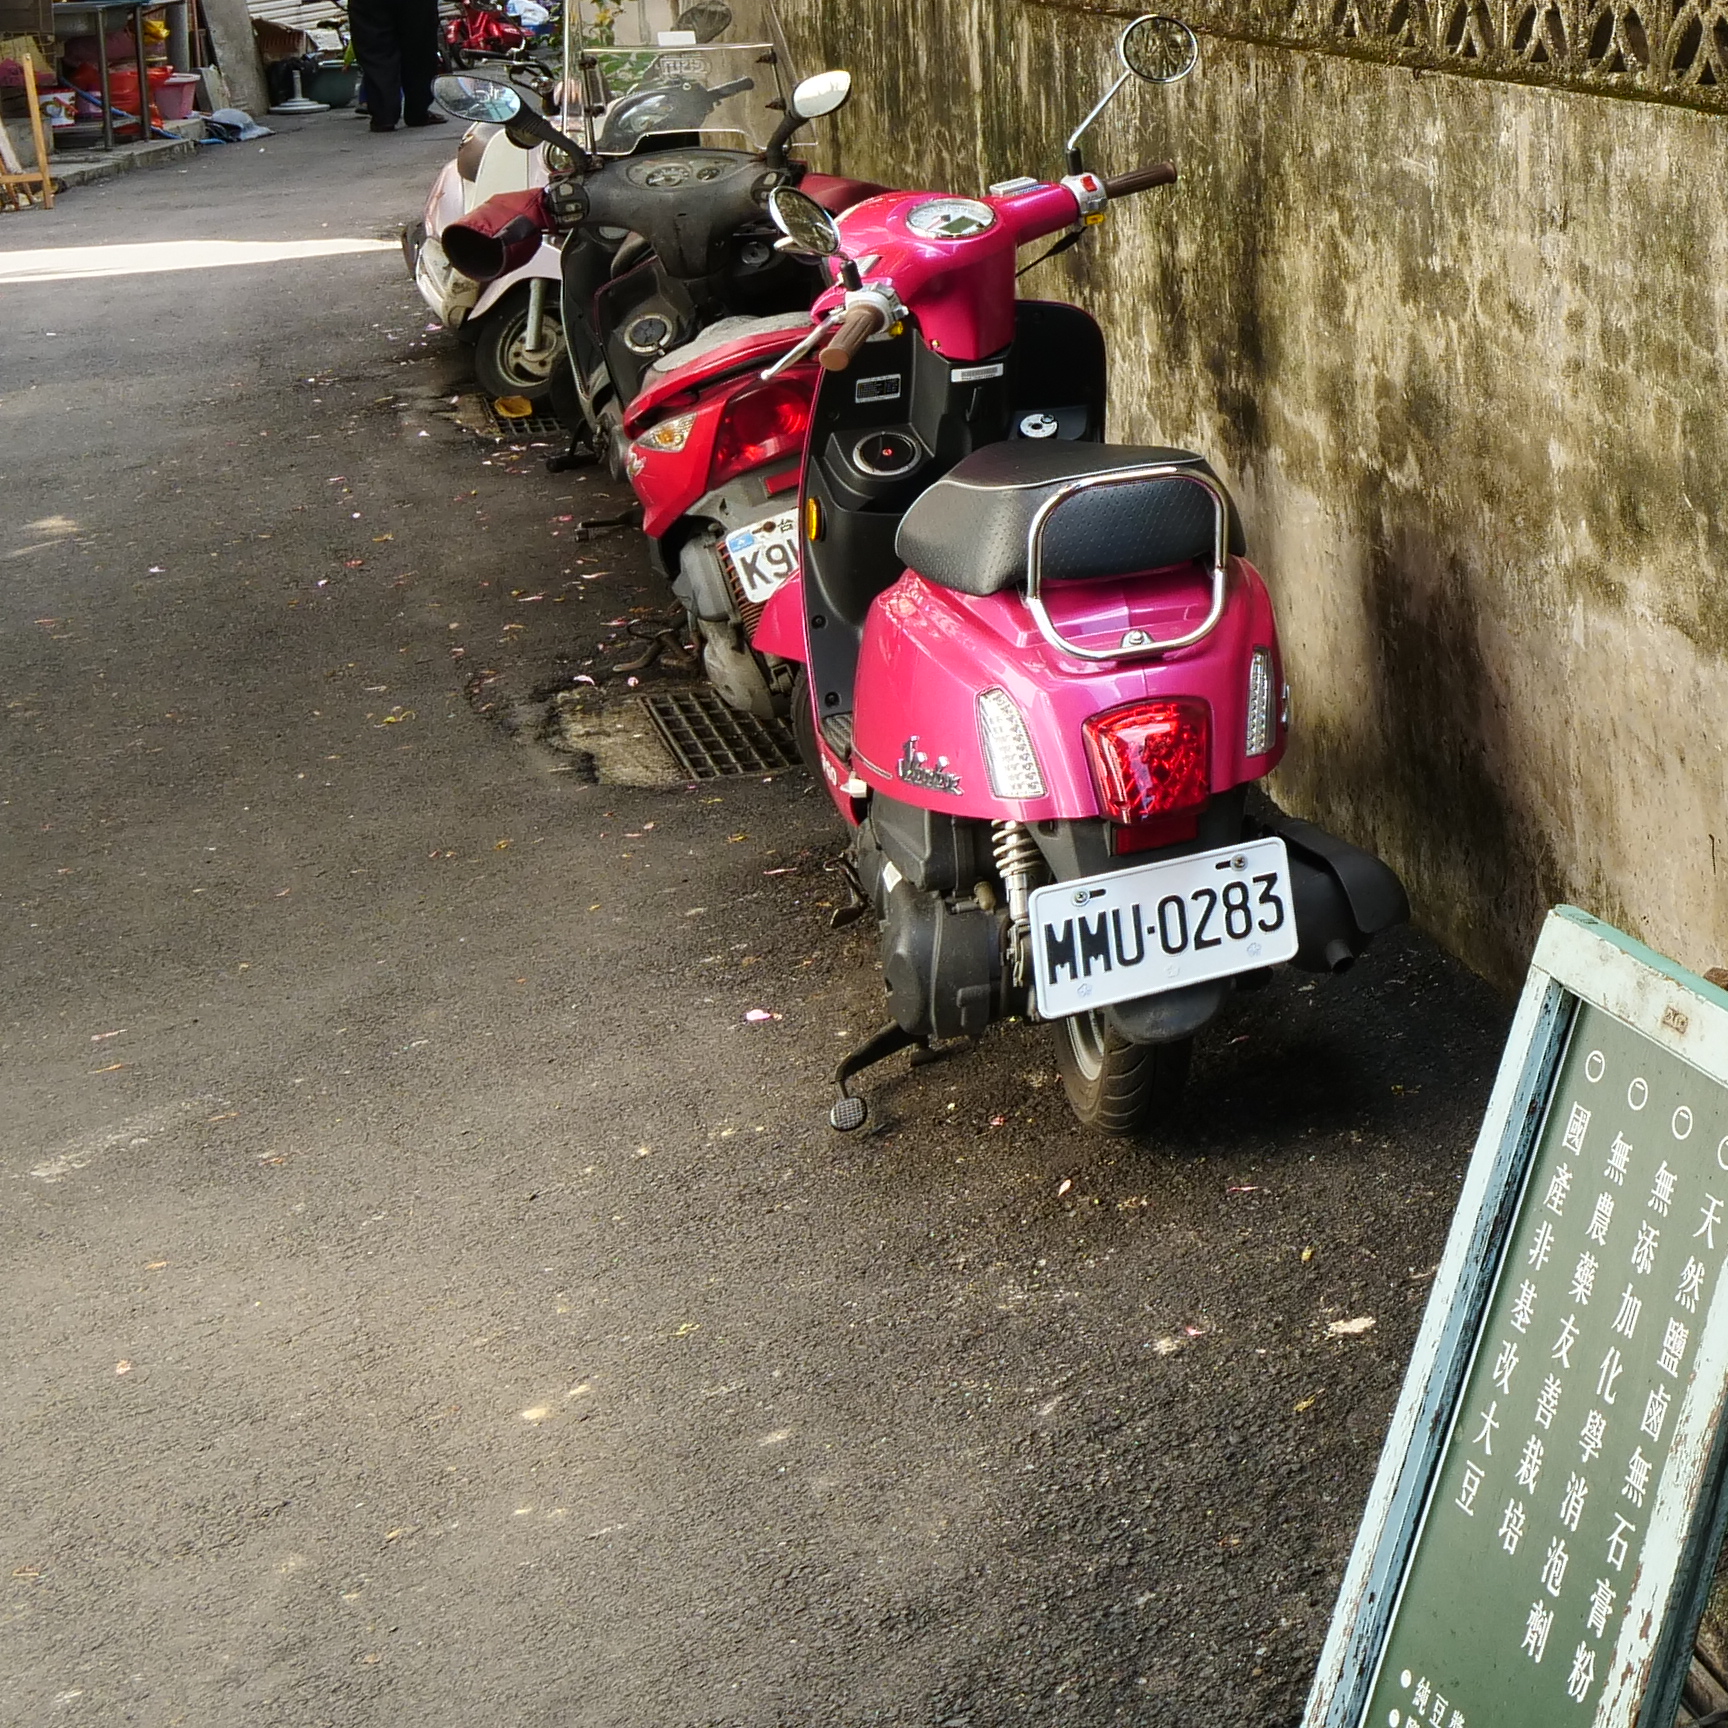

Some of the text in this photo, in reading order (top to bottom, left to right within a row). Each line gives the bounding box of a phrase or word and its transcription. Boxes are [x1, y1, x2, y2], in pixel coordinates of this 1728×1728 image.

[1044, 872, 1286, 987] MMU-0283
[1454, 1100, 1592, 1517] 國產非基改大豆
[1497, 1130, 1634, 1556] 無農藥友善栽培
[1520, 1160, 1679, 1664] 無添加化學消泡劑
